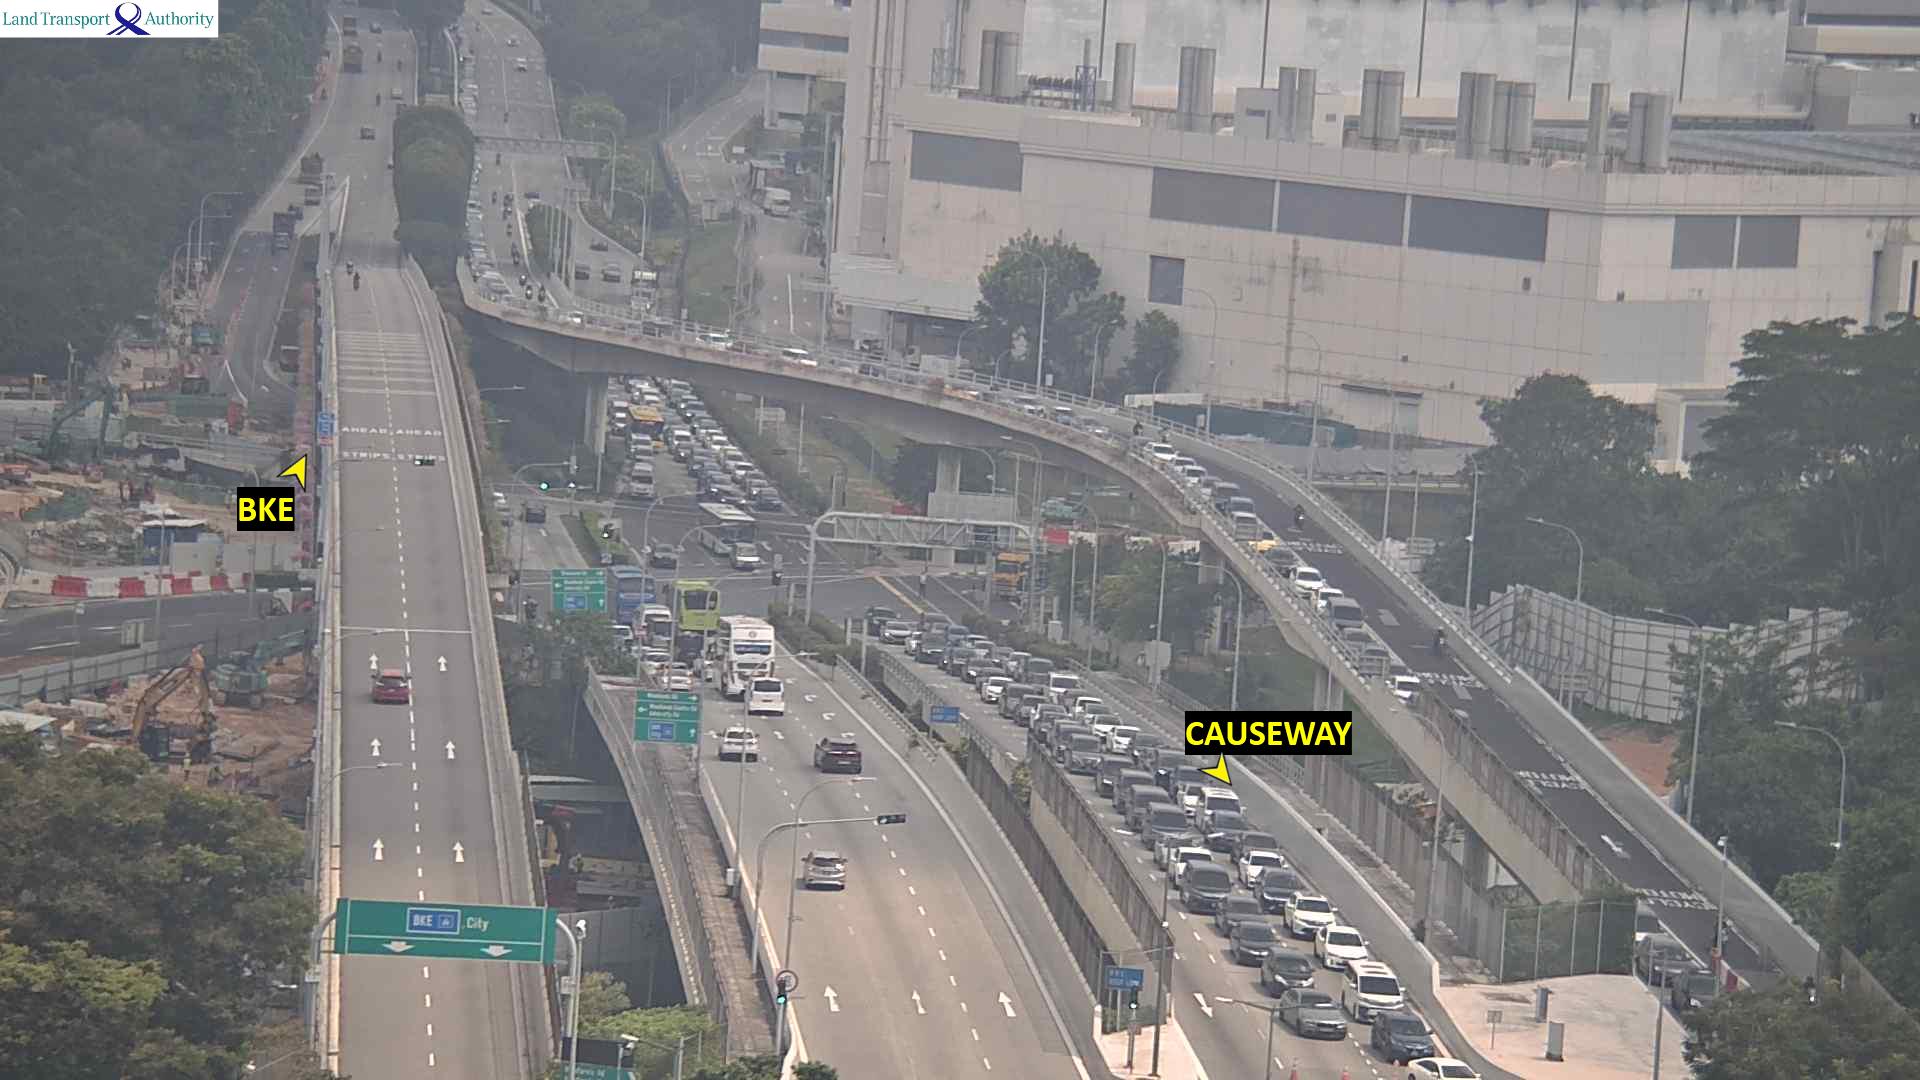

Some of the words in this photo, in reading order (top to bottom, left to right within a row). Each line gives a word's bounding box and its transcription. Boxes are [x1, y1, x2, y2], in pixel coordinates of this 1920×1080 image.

[341, 426, 388, 434] AHEAD
[395, 428, 442, 436] AHEAD
[342, 451, 392, 460] STRIPS
[412, 914, 432, 927] BKE
[466, 916, 489, 932] City
